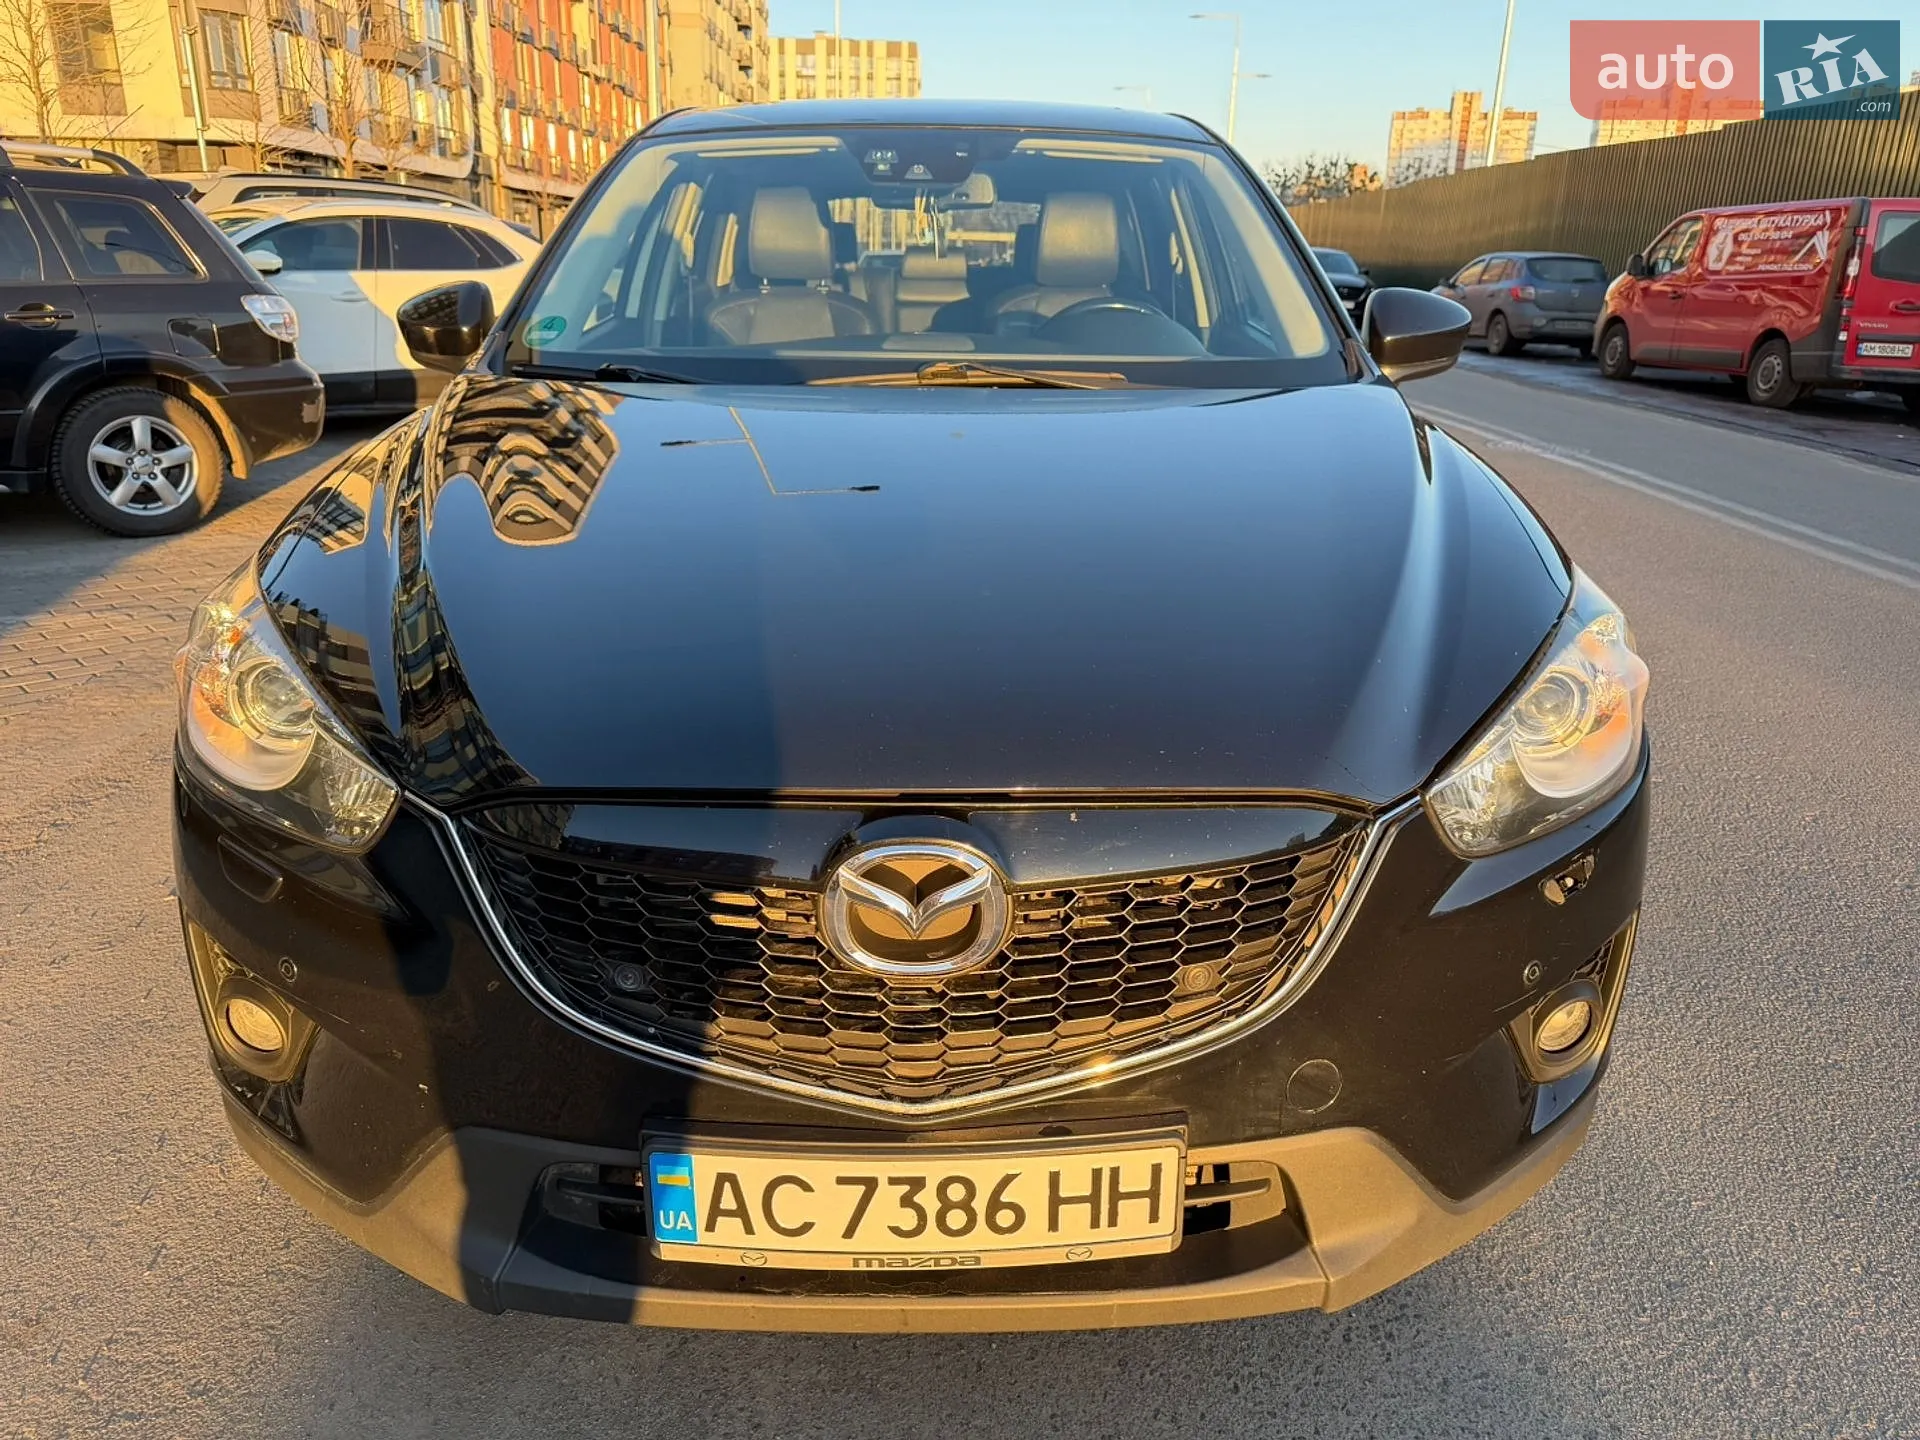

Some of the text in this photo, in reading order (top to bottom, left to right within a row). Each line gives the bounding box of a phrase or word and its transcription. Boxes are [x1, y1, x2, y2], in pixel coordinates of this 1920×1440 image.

[704, 1162, 1162, 1240] AC 7386 HH
[659, 1210, 693, 1232] UA
[852, 1255, 981, 1269] mazda
